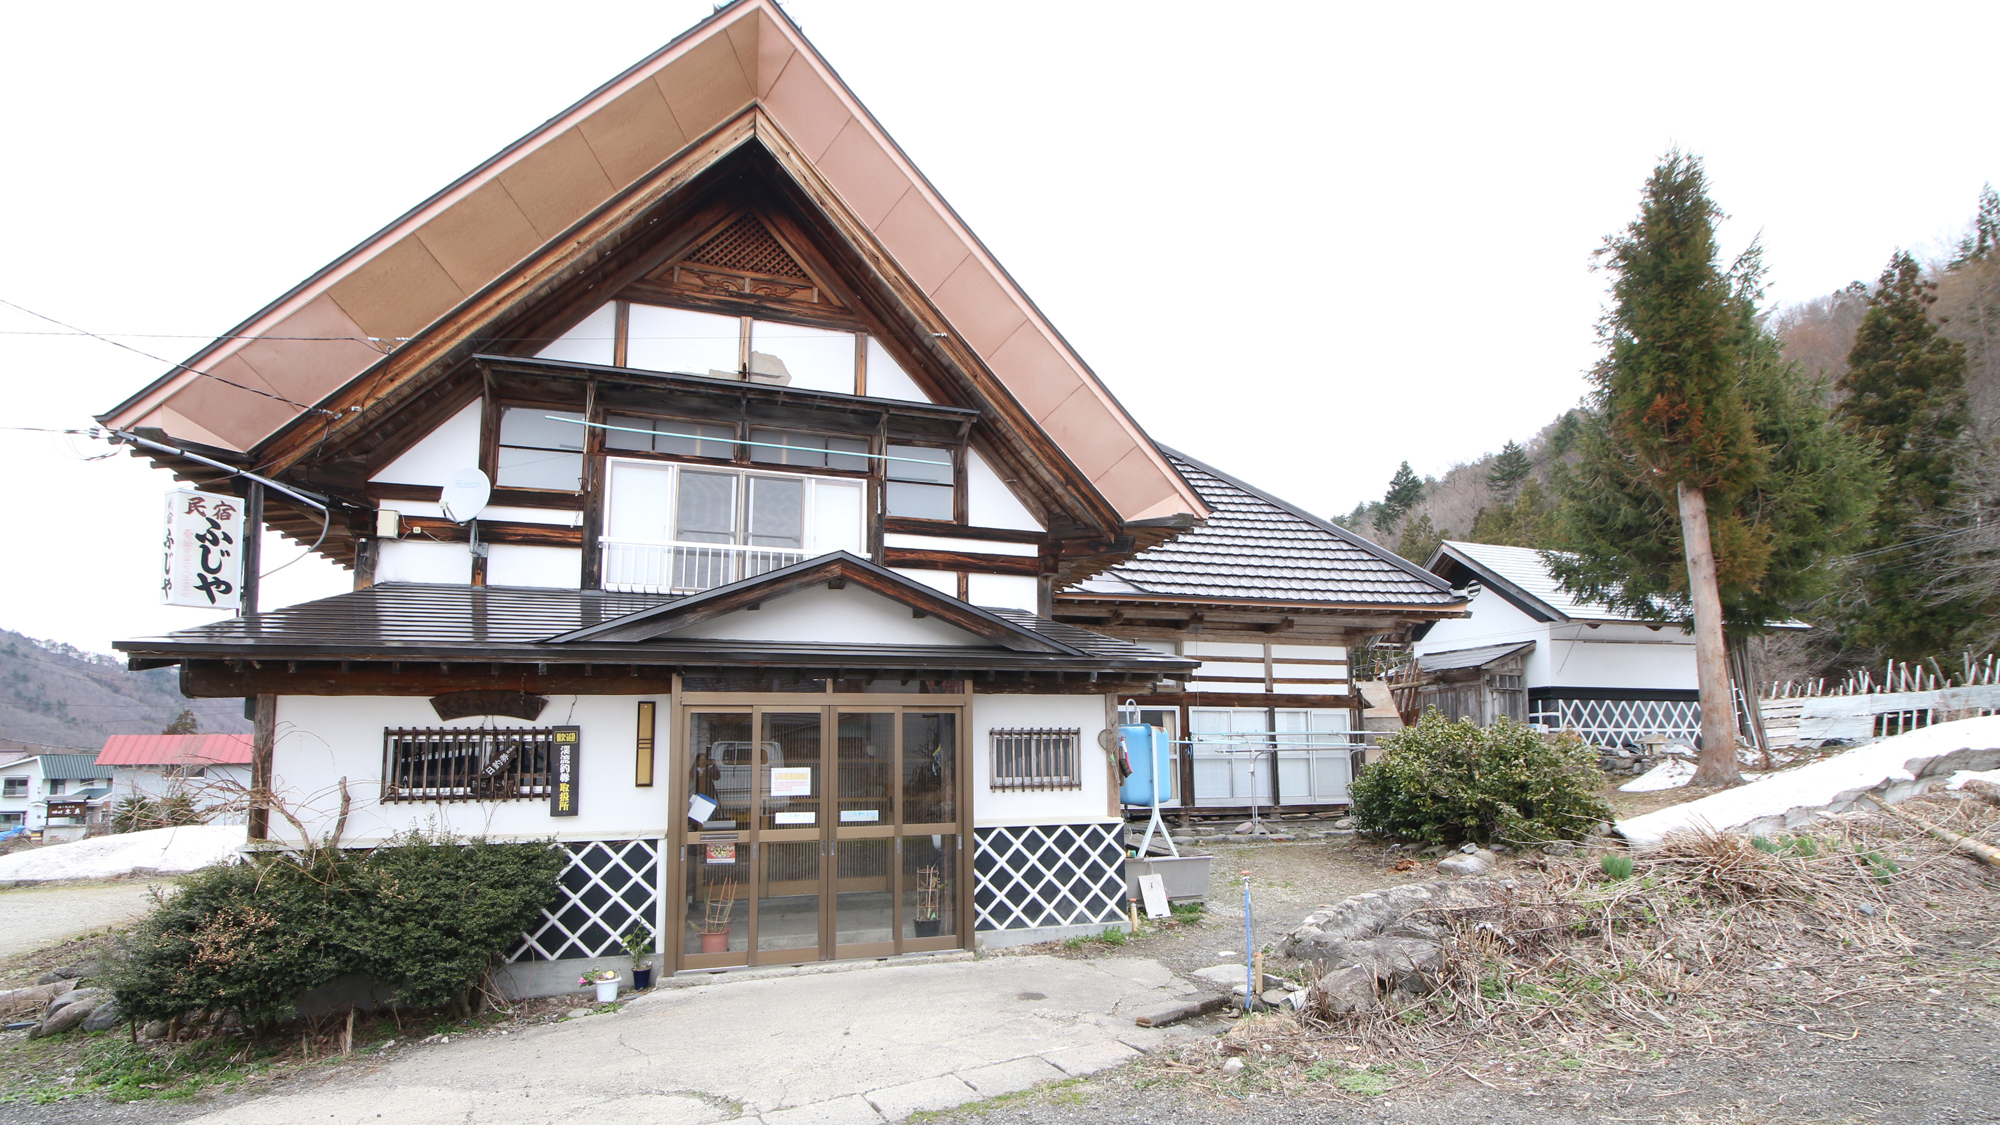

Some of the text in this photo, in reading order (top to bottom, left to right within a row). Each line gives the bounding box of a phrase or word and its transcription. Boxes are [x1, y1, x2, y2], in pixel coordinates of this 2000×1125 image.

[183, 496, 237, 521] 民宿
[193, 516, 234, 605] ふじや
[556, 732, 576, 742] 歓迎
